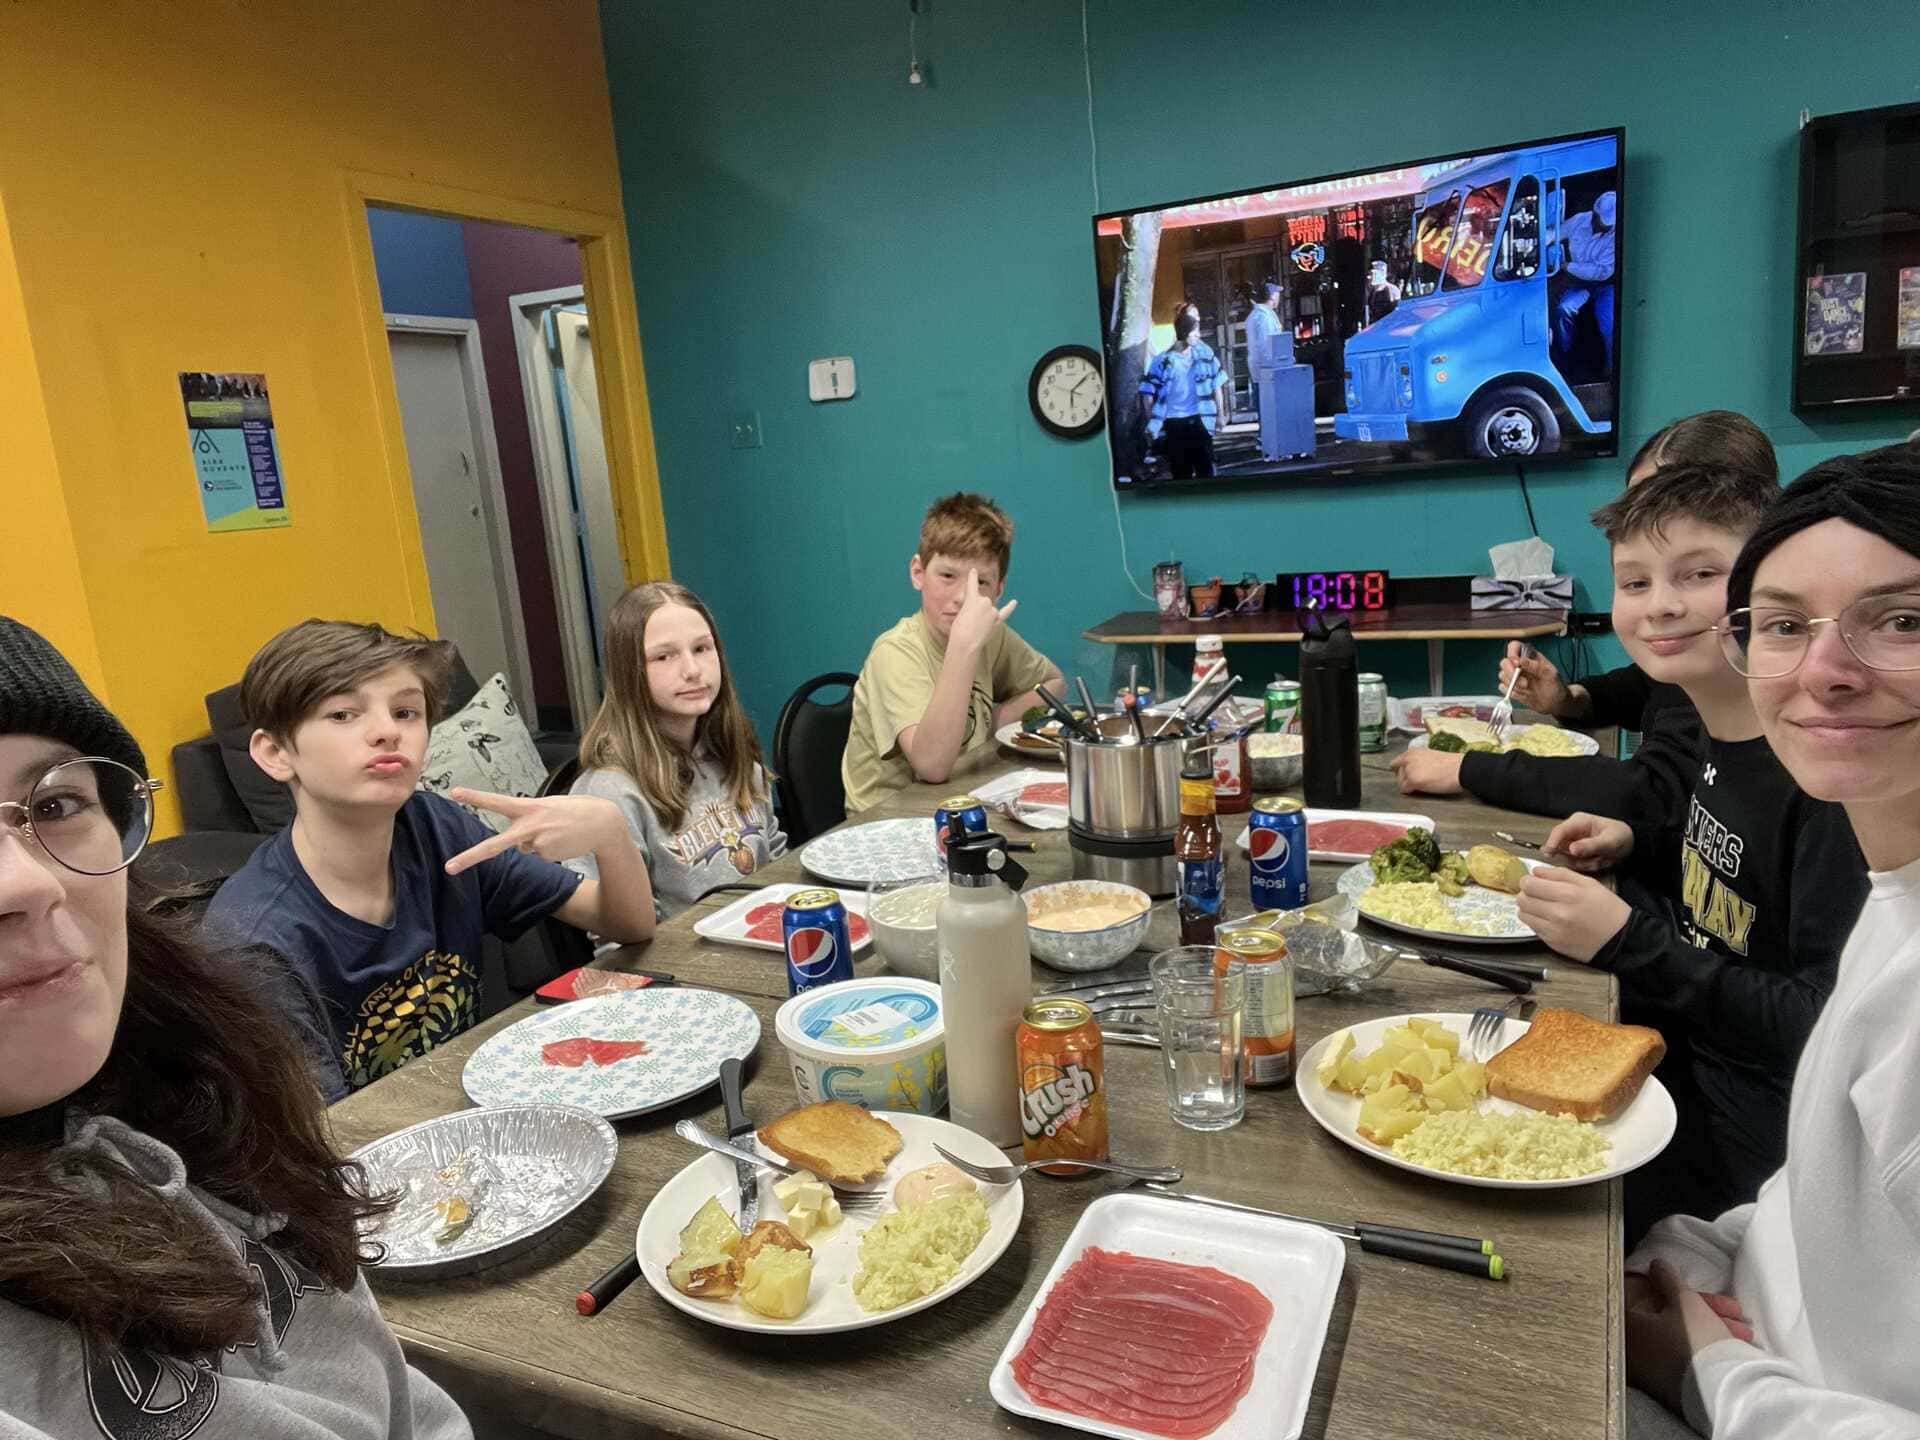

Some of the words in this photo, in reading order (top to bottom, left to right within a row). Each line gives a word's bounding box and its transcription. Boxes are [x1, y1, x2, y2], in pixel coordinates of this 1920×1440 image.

[1252, 875, 1286, 889] pepsi
[357, 982, 393, 1017] VANS
[1018, 1064, 1097, 1137] Crush
